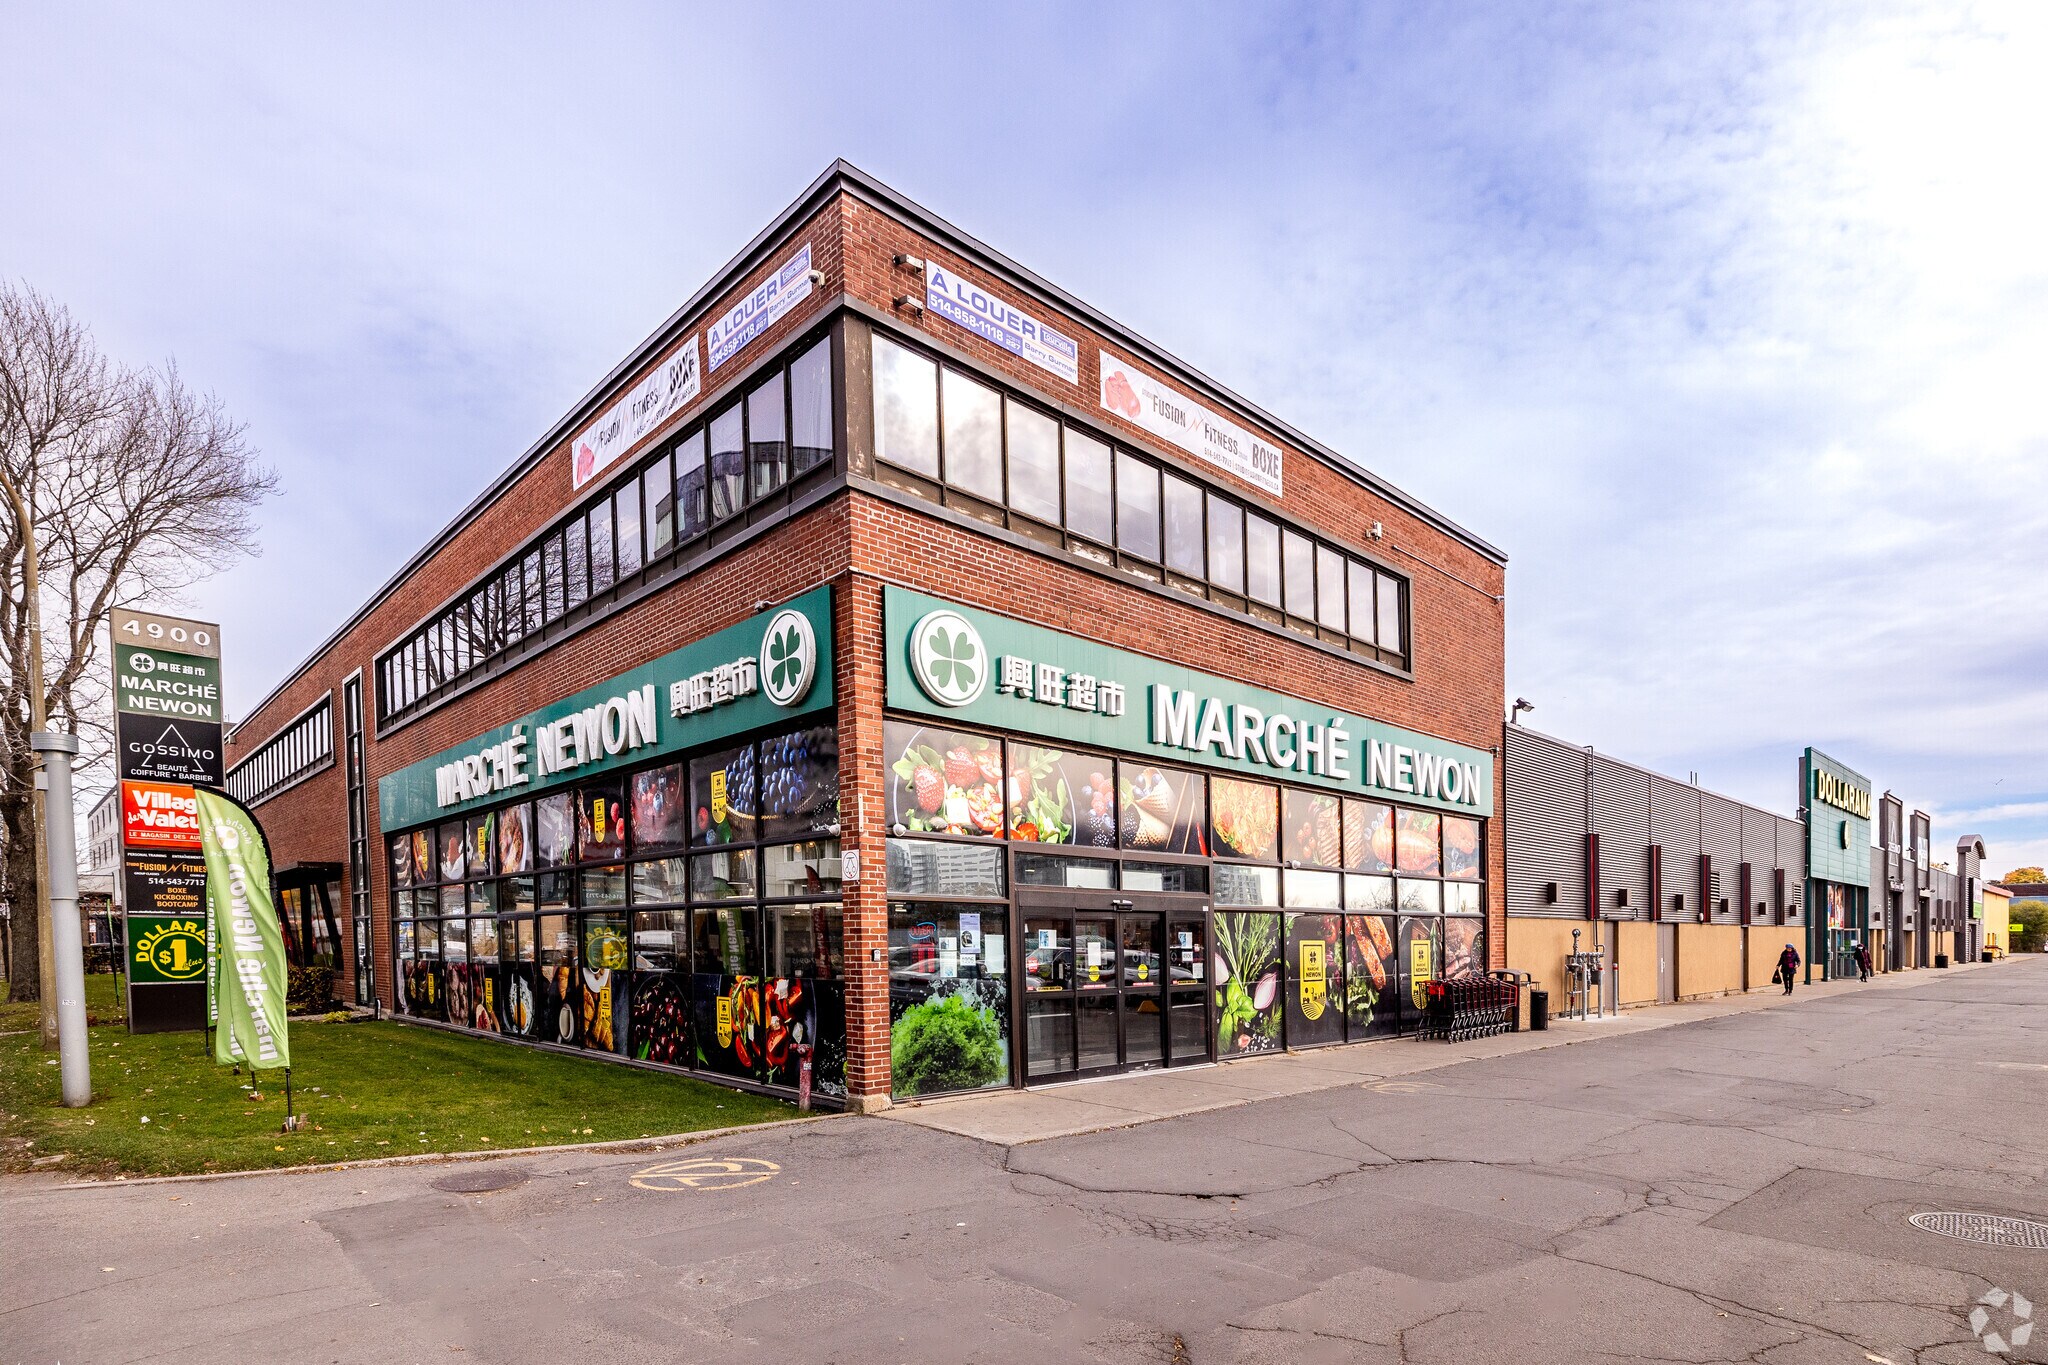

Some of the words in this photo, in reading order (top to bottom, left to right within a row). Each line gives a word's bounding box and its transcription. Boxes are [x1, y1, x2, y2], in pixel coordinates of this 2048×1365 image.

[724, 280, 777, 336] LOUER
[930, 267, 949, 294] À
[957, 283, 1036, 340] LOUER
[930, 294, 1004, 342] 514-858-1118
[669, 347, 695, 395] BOXE
[1024, 342, 1047, 360] Barry
[1048, 355, 1077, 374] Gurman
[1153, 396, 1186, 428] FUSION
[1205, 422, 1238, 456] FITNESS
[1252, 442, 1279, 480] BOXE
[122, 619, 211, 646] 4900
[157, 662, 206, 677] 興旺超市
[121, 674, 217, 700] MARCHÉ
[128, 695, 212, 717] NEWON
[435, 723, 529, 808] MARCHÉ
[536, 683, 657, 777] NEWON
[670, 656, 757, 718] 興旺超市
[1000, 654, 1125, 716] 興旺超市
[1151, 682, 1350, 780] MARCHÉ
[1366, 737, 1481, 805] NEWON
[129, 742, 215, 760] GOSSIMO
[130, 768, 171, 779] COIFFURE
[178, 772, 213, 782] BARBIER
[157, 763, 188, 773] BEAUTÉ
[132, 790, 197, 815] Villag
[1816, 768, 1871, 820] DOLLARAMA
[140, 809, 200, 829] Valeu
[139, 862, 167, 871] FUSION
[182, 864, 207, 873] FITNES
[148, 878, 205, 886] 514-543-7713
